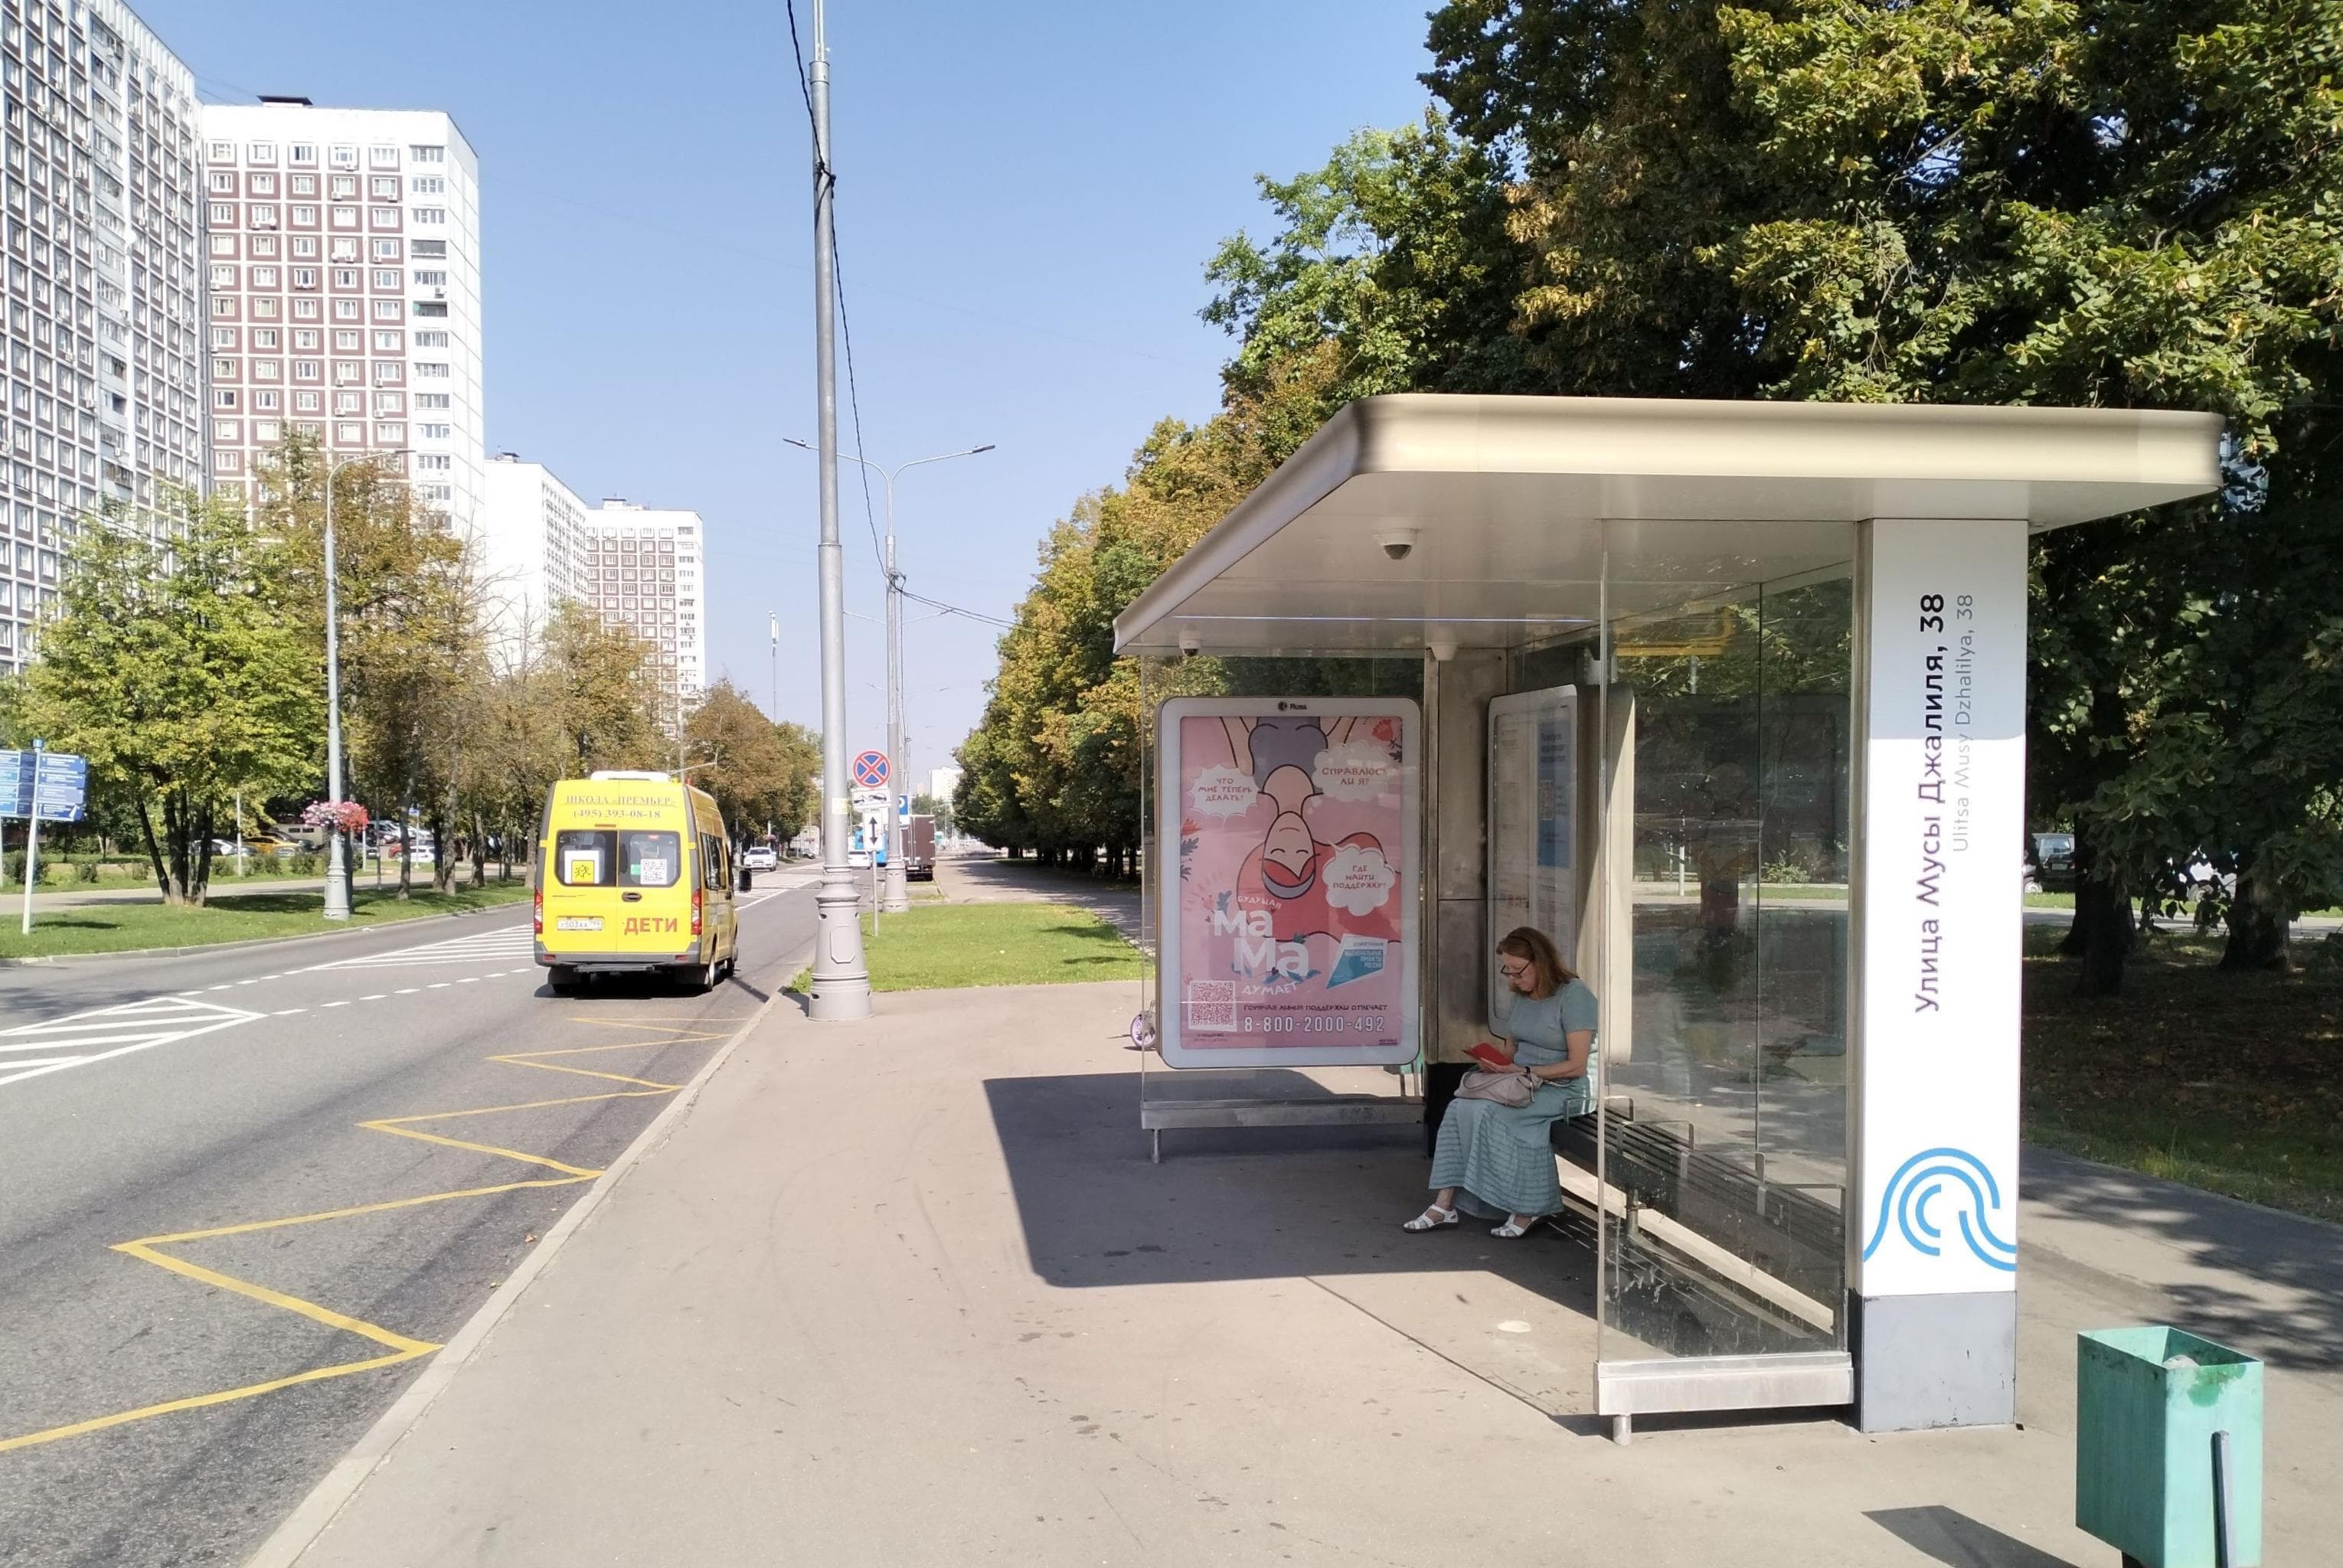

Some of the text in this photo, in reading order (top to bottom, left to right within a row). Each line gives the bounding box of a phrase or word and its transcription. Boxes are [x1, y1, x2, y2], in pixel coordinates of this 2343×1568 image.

[1953, 594, 1975, 851] Ulitsa Musy Dzhalilya, 38
[566, 795, 609, 805] ШКОЛА
[1915, 593, 1948, 1013] Улица Мусы Джалиля, 38
[573, 809, 661, 818] (495) 393-08-18
[624, 917, 678, 936] ДЕТИ
[1242, 980, 1298, 995] ДУМАЕТ
[1243, 1015, 1385, 1033] 8-800-2000-492
